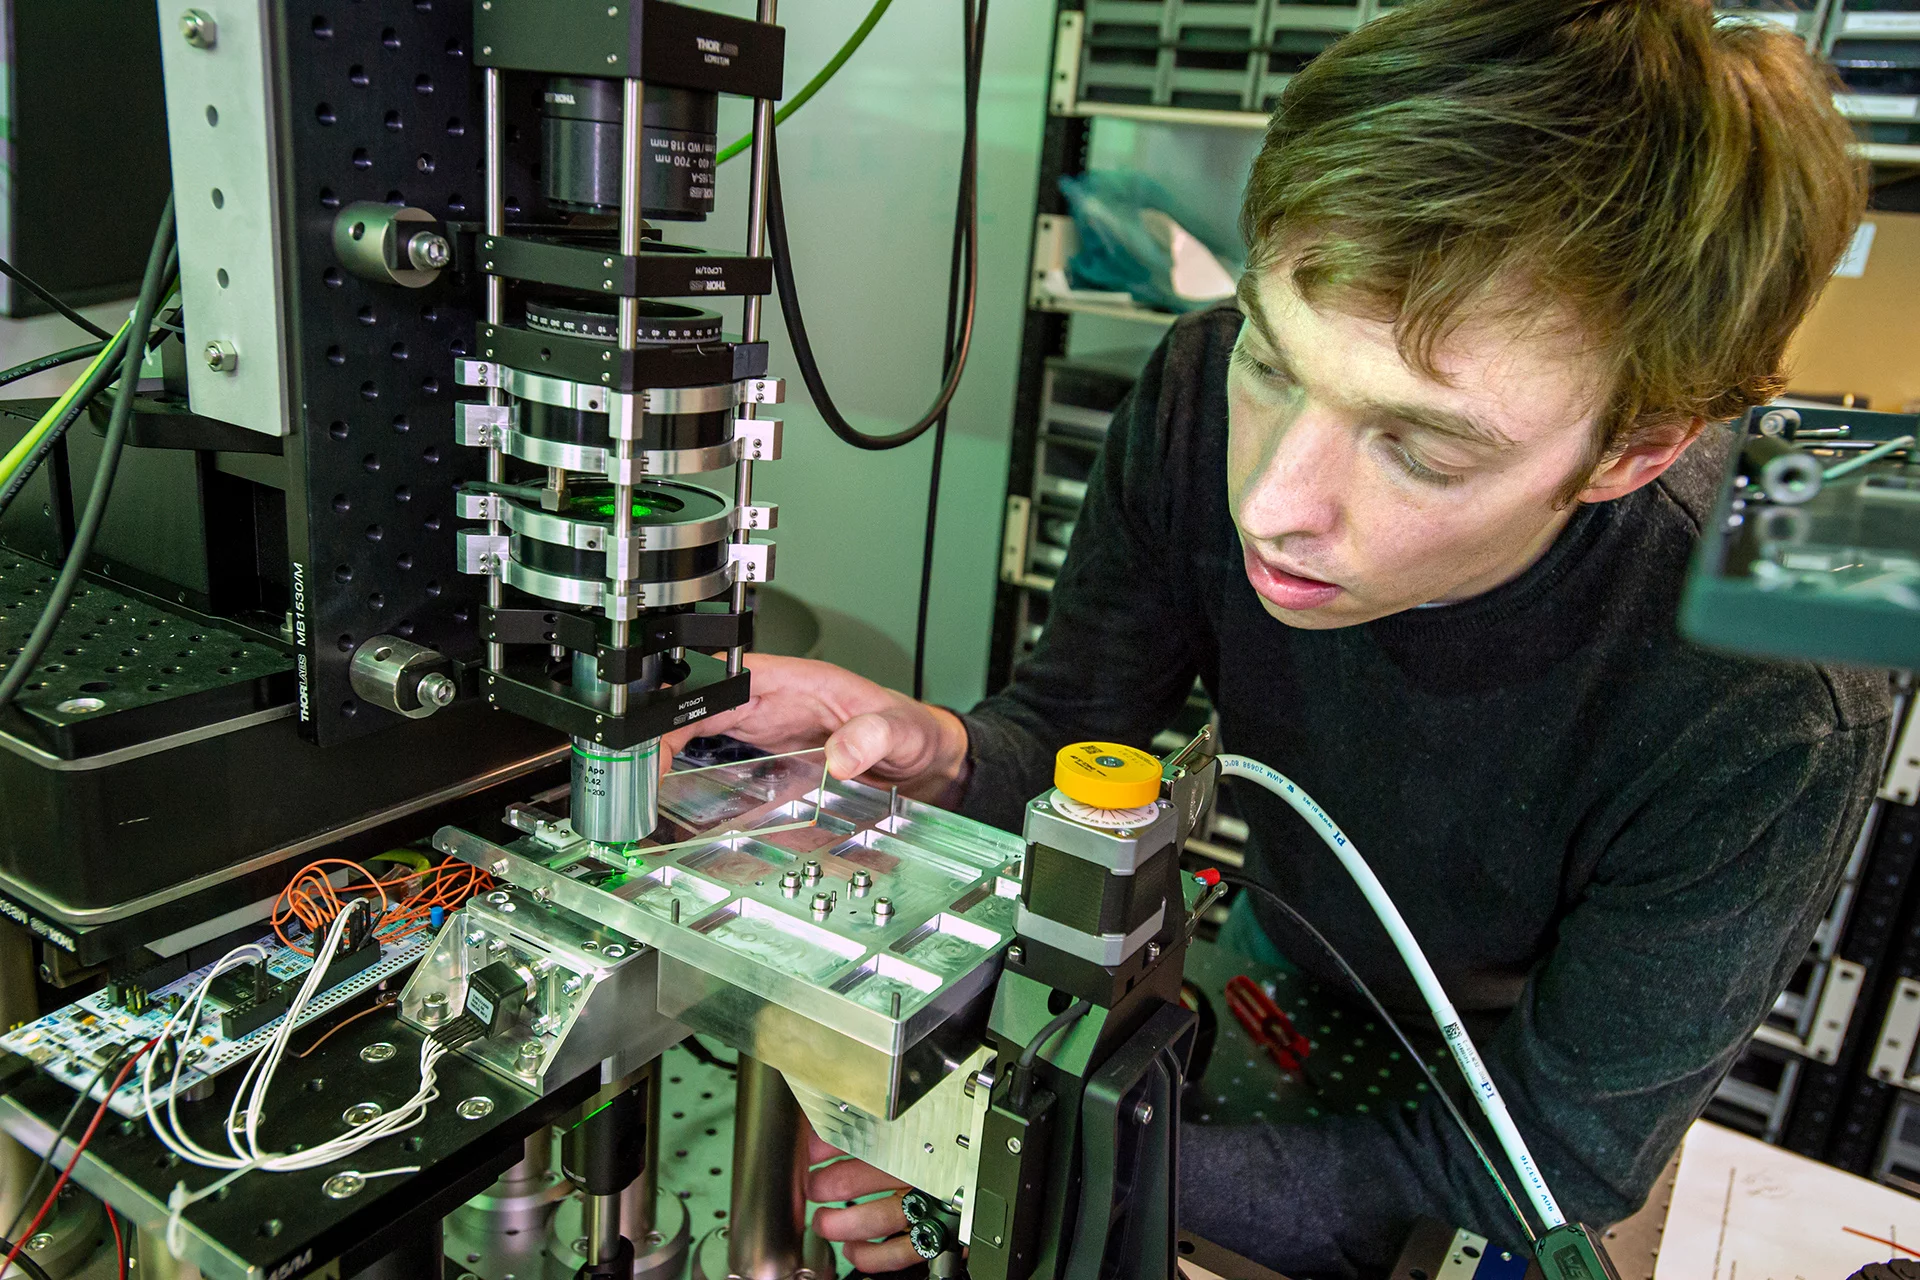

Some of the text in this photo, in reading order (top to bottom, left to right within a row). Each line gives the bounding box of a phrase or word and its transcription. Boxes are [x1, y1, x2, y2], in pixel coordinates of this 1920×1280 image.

[650, 138, 669, 148] mm
[671, 140, 685, 150] 118
[655, 154, 671, 164] nm
[674, 156, 690, 167] 700
[582, 324, 588, 332] 0
[1, 365, 33, 383] CABLE
[293, 562, 309, 722] THORLABS MB1530/M
[678, 696, 704, 710] LCP01/M
[673, 706, 708, 726] THORLABS
[588, 766, 605, 775] Apo
[1266, 770, 1284, 784] AWM
[584, 776, 601, 786] 0.42
[1333, 830, 1347, 847] PI
[1480, 1080, 1495, 1100] PI
[910, 1226, 938, 1259] THORLABS
